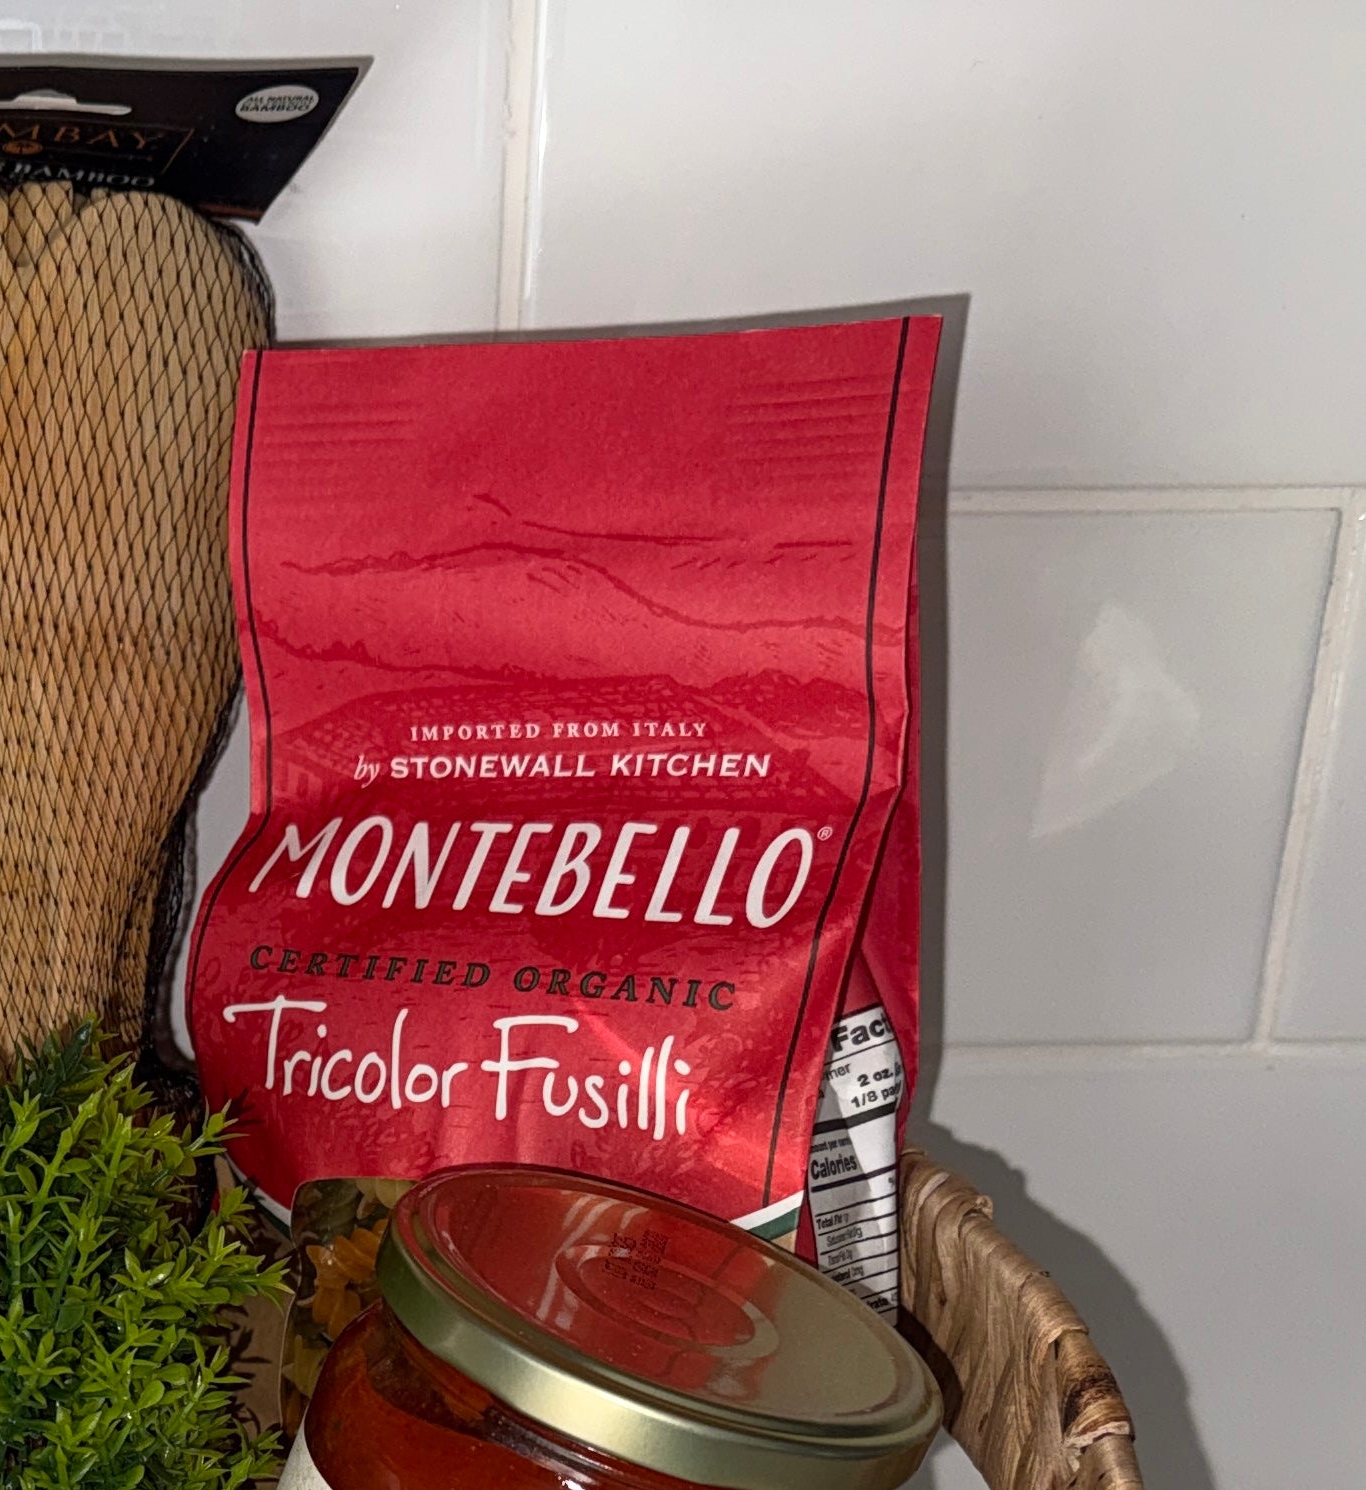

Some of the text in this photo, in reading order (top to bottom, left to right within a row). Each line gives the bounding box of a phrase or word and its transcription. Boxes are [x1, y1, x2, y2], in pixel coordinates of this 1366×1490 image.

[12, 161, 156, 188] BAMBOO
[409, 720, 709, 743] IMPORTED FROM ITALY
[353, 752, 772, 788] by STONEWALL KITCHEN
[250, 945, 736, 1011] CERTIFIED ORGANIC
[224, 996, 692, 1141] Tricolor Fusilli
[857, 1073, 870, 1088] 2
[851, 1090, 878, 1108] 1/8
[811, 1153, 858, 1181] Calories
